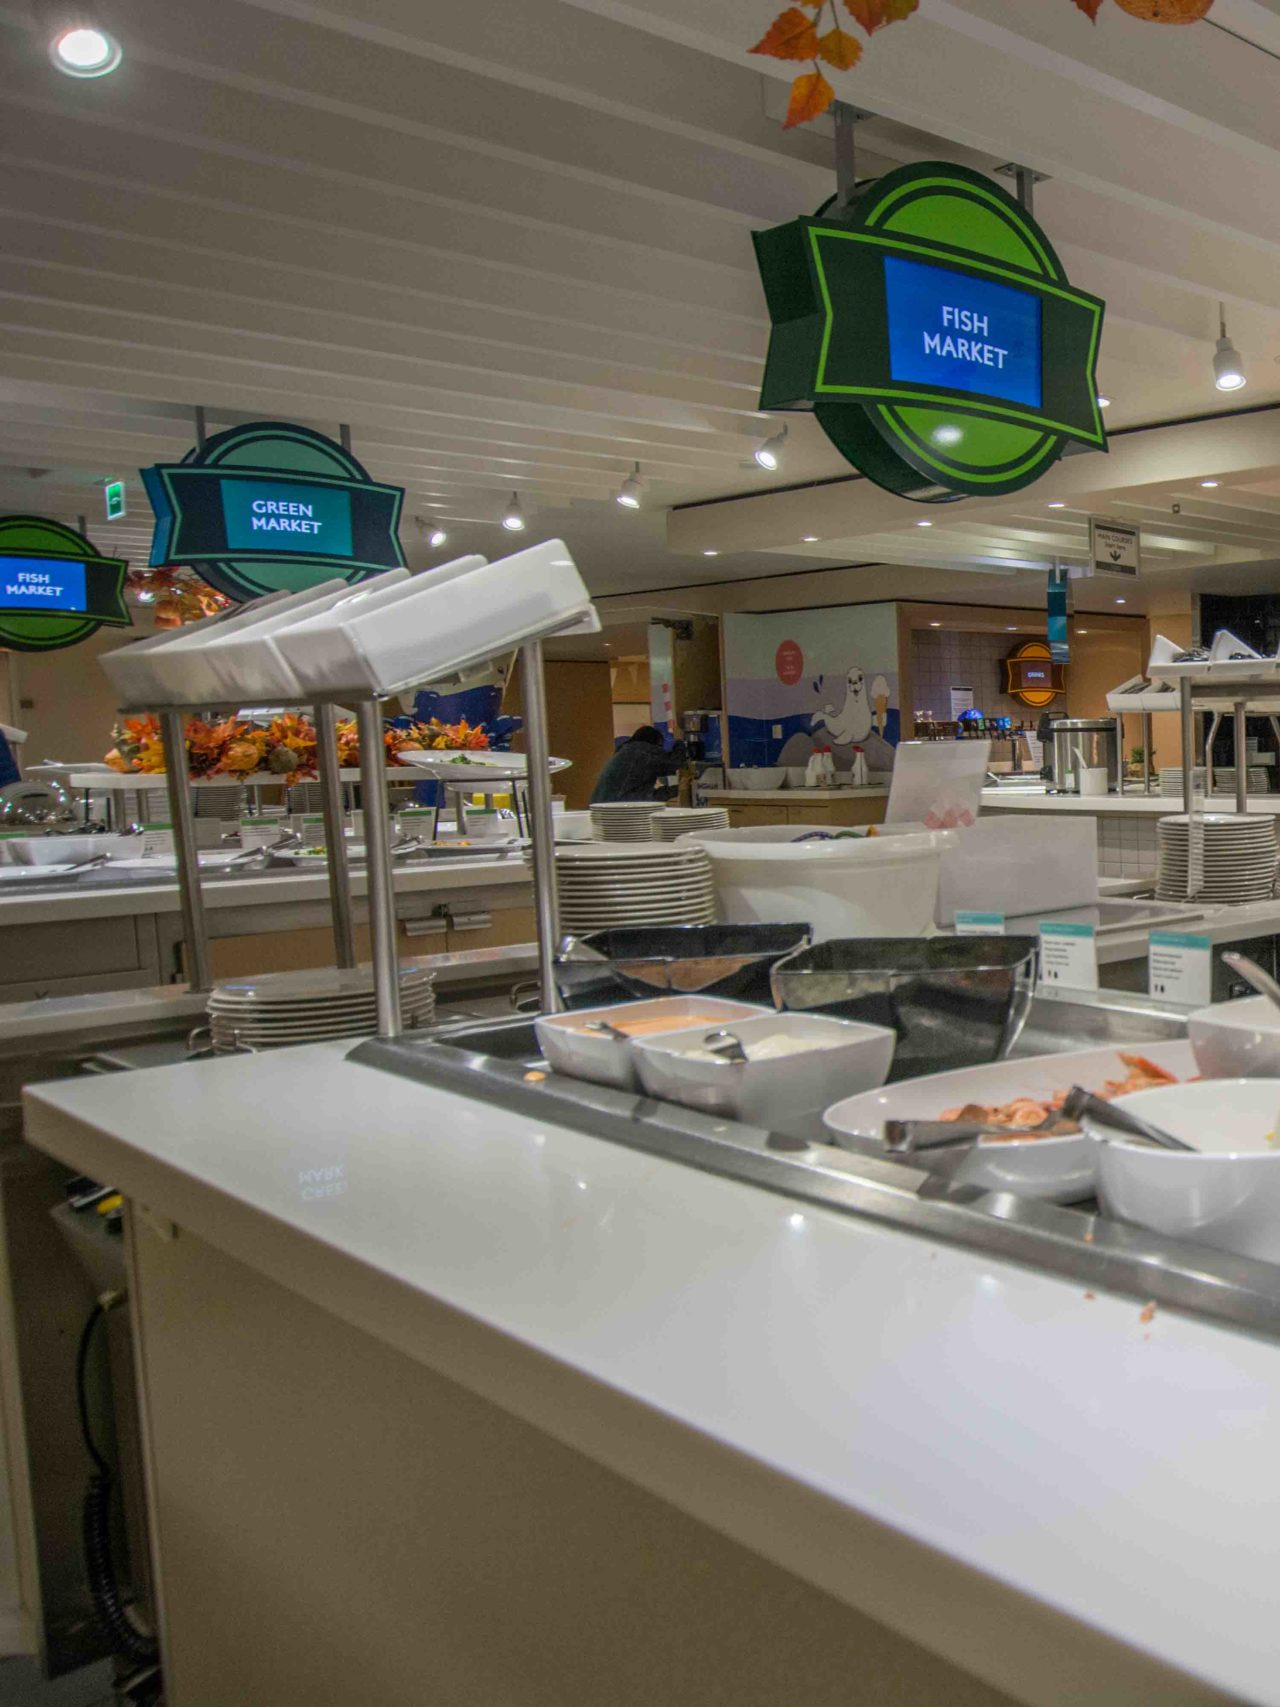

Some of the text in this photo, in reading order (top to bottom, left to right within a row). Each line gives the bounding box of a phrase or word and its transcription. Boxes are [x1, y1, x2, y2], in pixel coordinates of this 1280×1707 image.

[942, 305, 989, 337] FISH
[922, 331, 1009, 369] MARKET
[251, 500, 313, 518] GREEN
[251, 516, 323, 535] MARKET
[17, 572, 51, 584] FISH
[5, 584, 65, 597] MARKET
